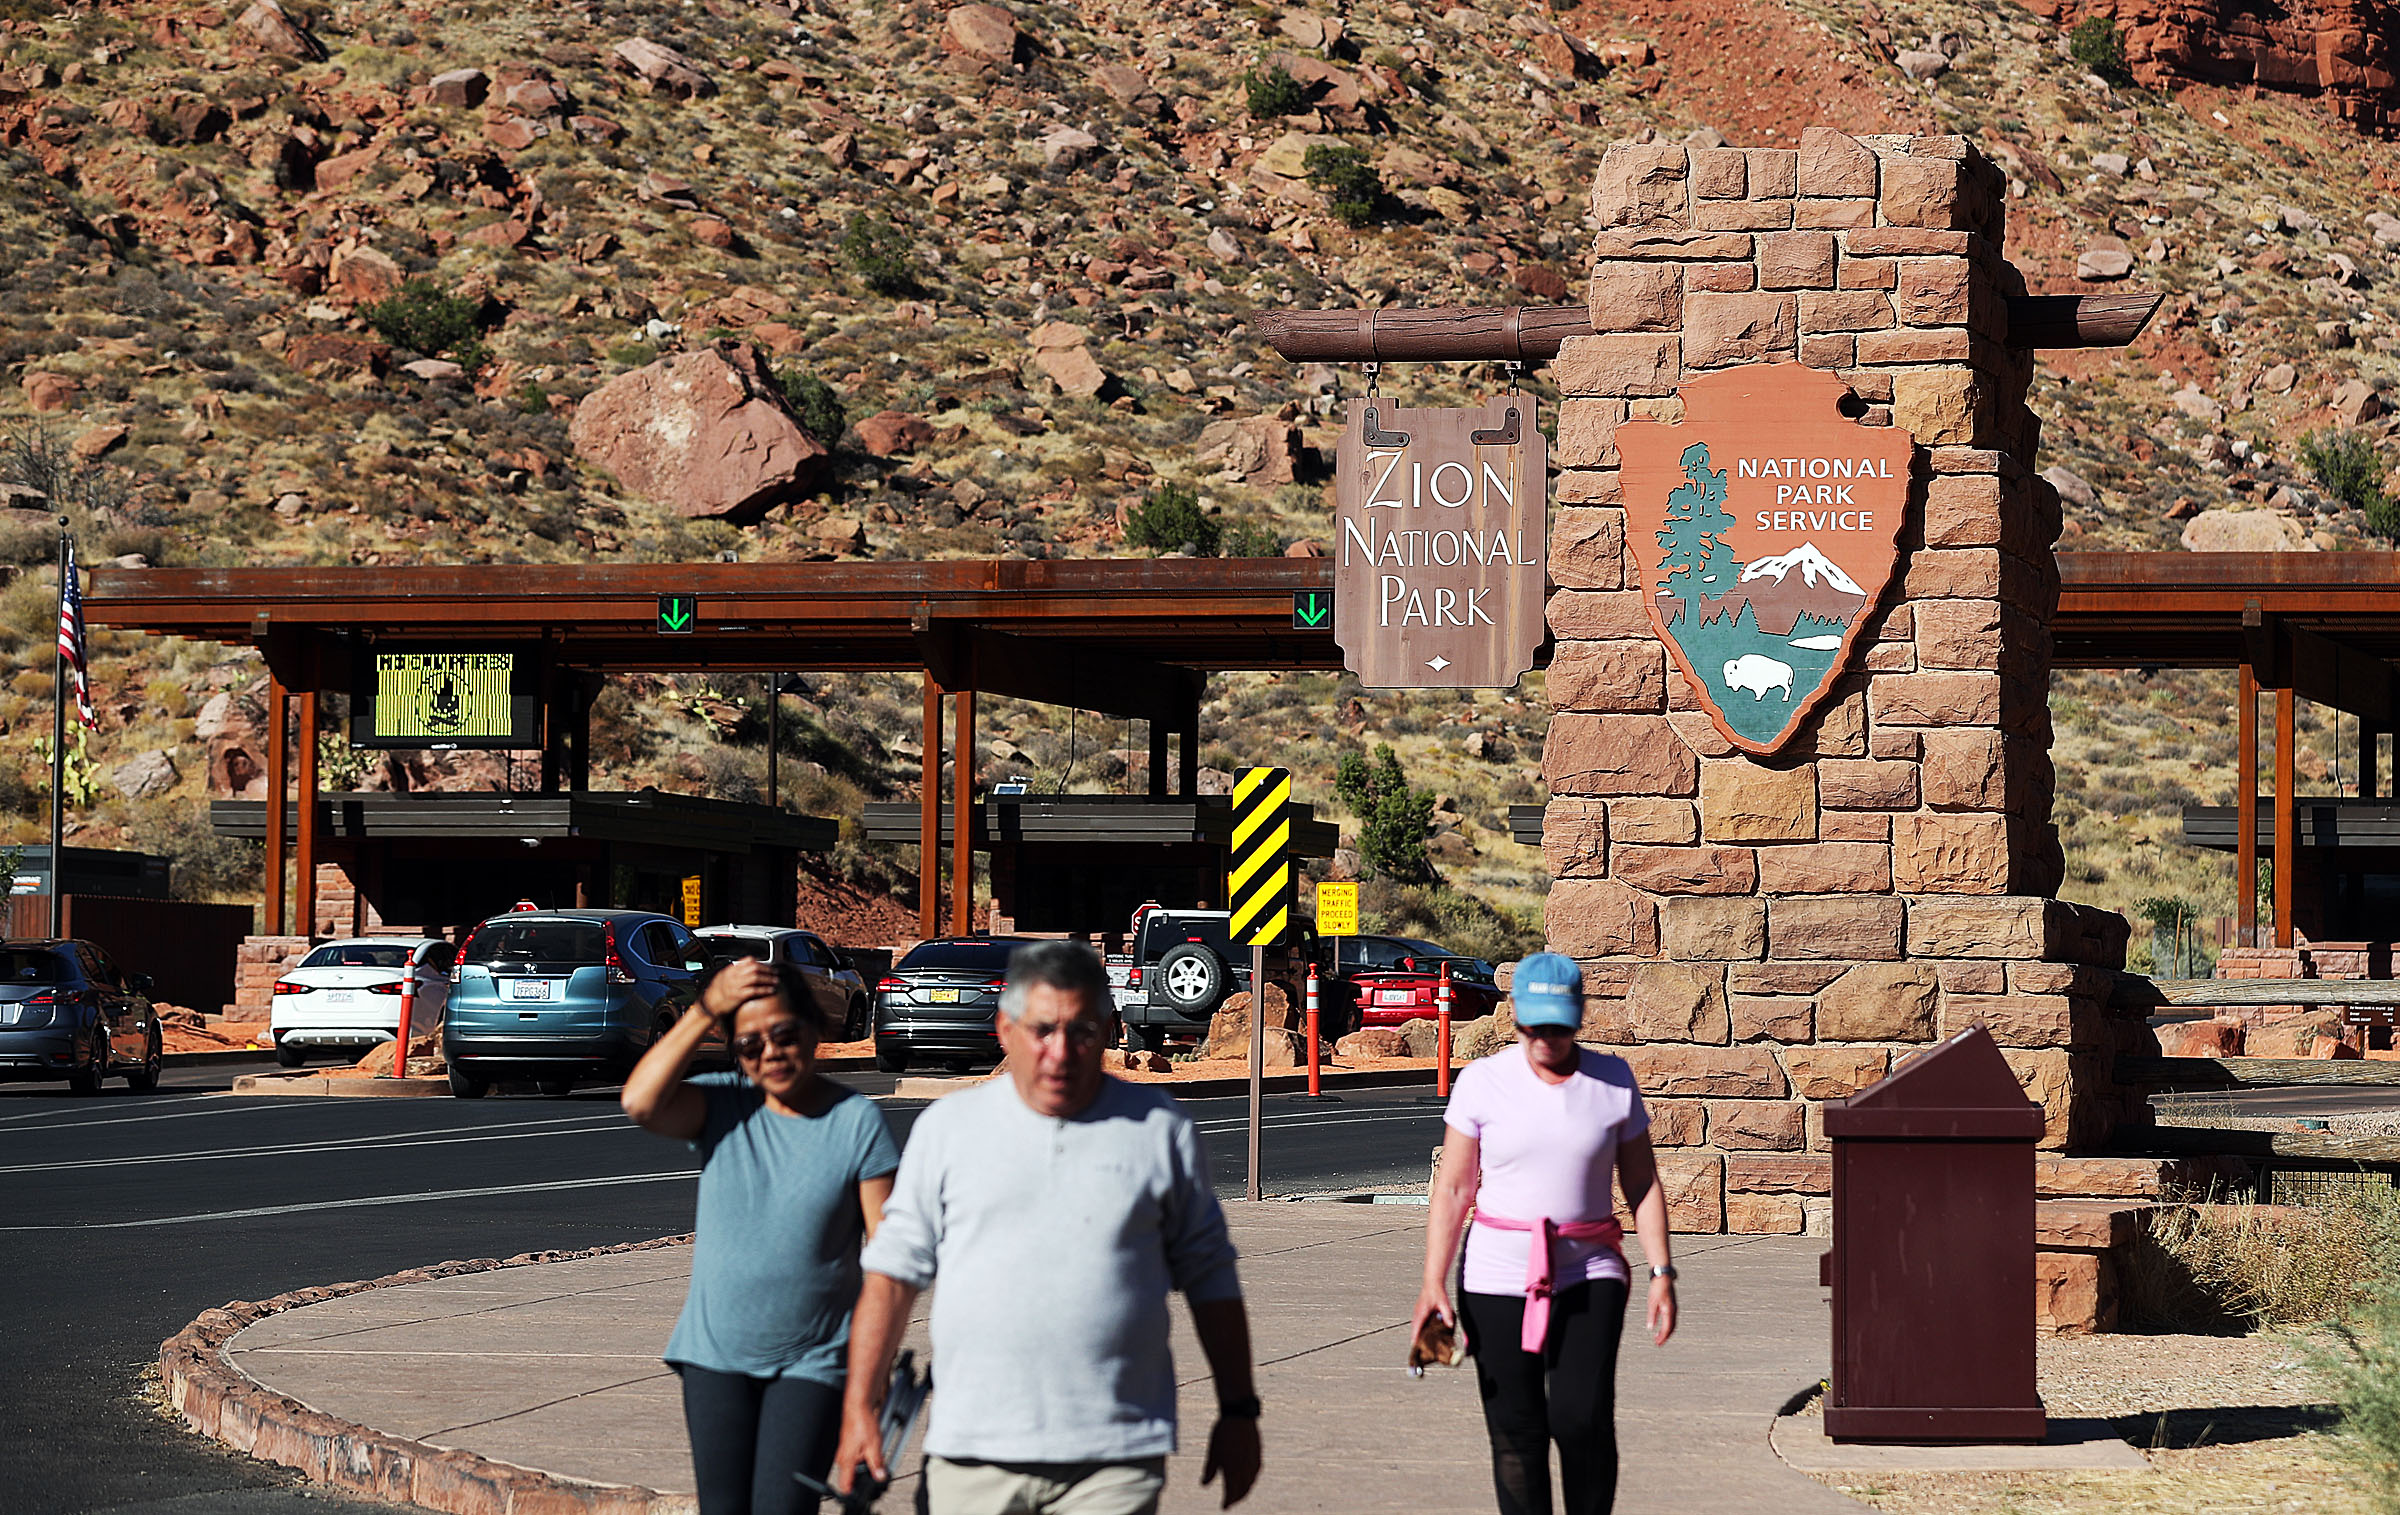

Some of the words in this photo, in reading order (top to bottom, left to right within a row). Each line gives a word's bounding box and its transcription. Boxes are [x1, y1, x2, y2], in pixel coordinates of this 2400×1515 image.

[1737, 457, 1895, 479] NATIONAL
[1363, 450, 1515, 508] ZION
[1776, 484, 1855, 505] PARK
[1755, 511, 1874, 531] SERVICE
[1343, 516, 1537, 567] NATIONAL
[1380, 575, 1496, 627] PARK
[1321, 888, 1353, 897] MERGING
[1322, 899, 1352, 908] TRAFFIC
[1321, 910, 1353, 919] PROCEED
[1323, 920, 1351, 929] SLOWLY
